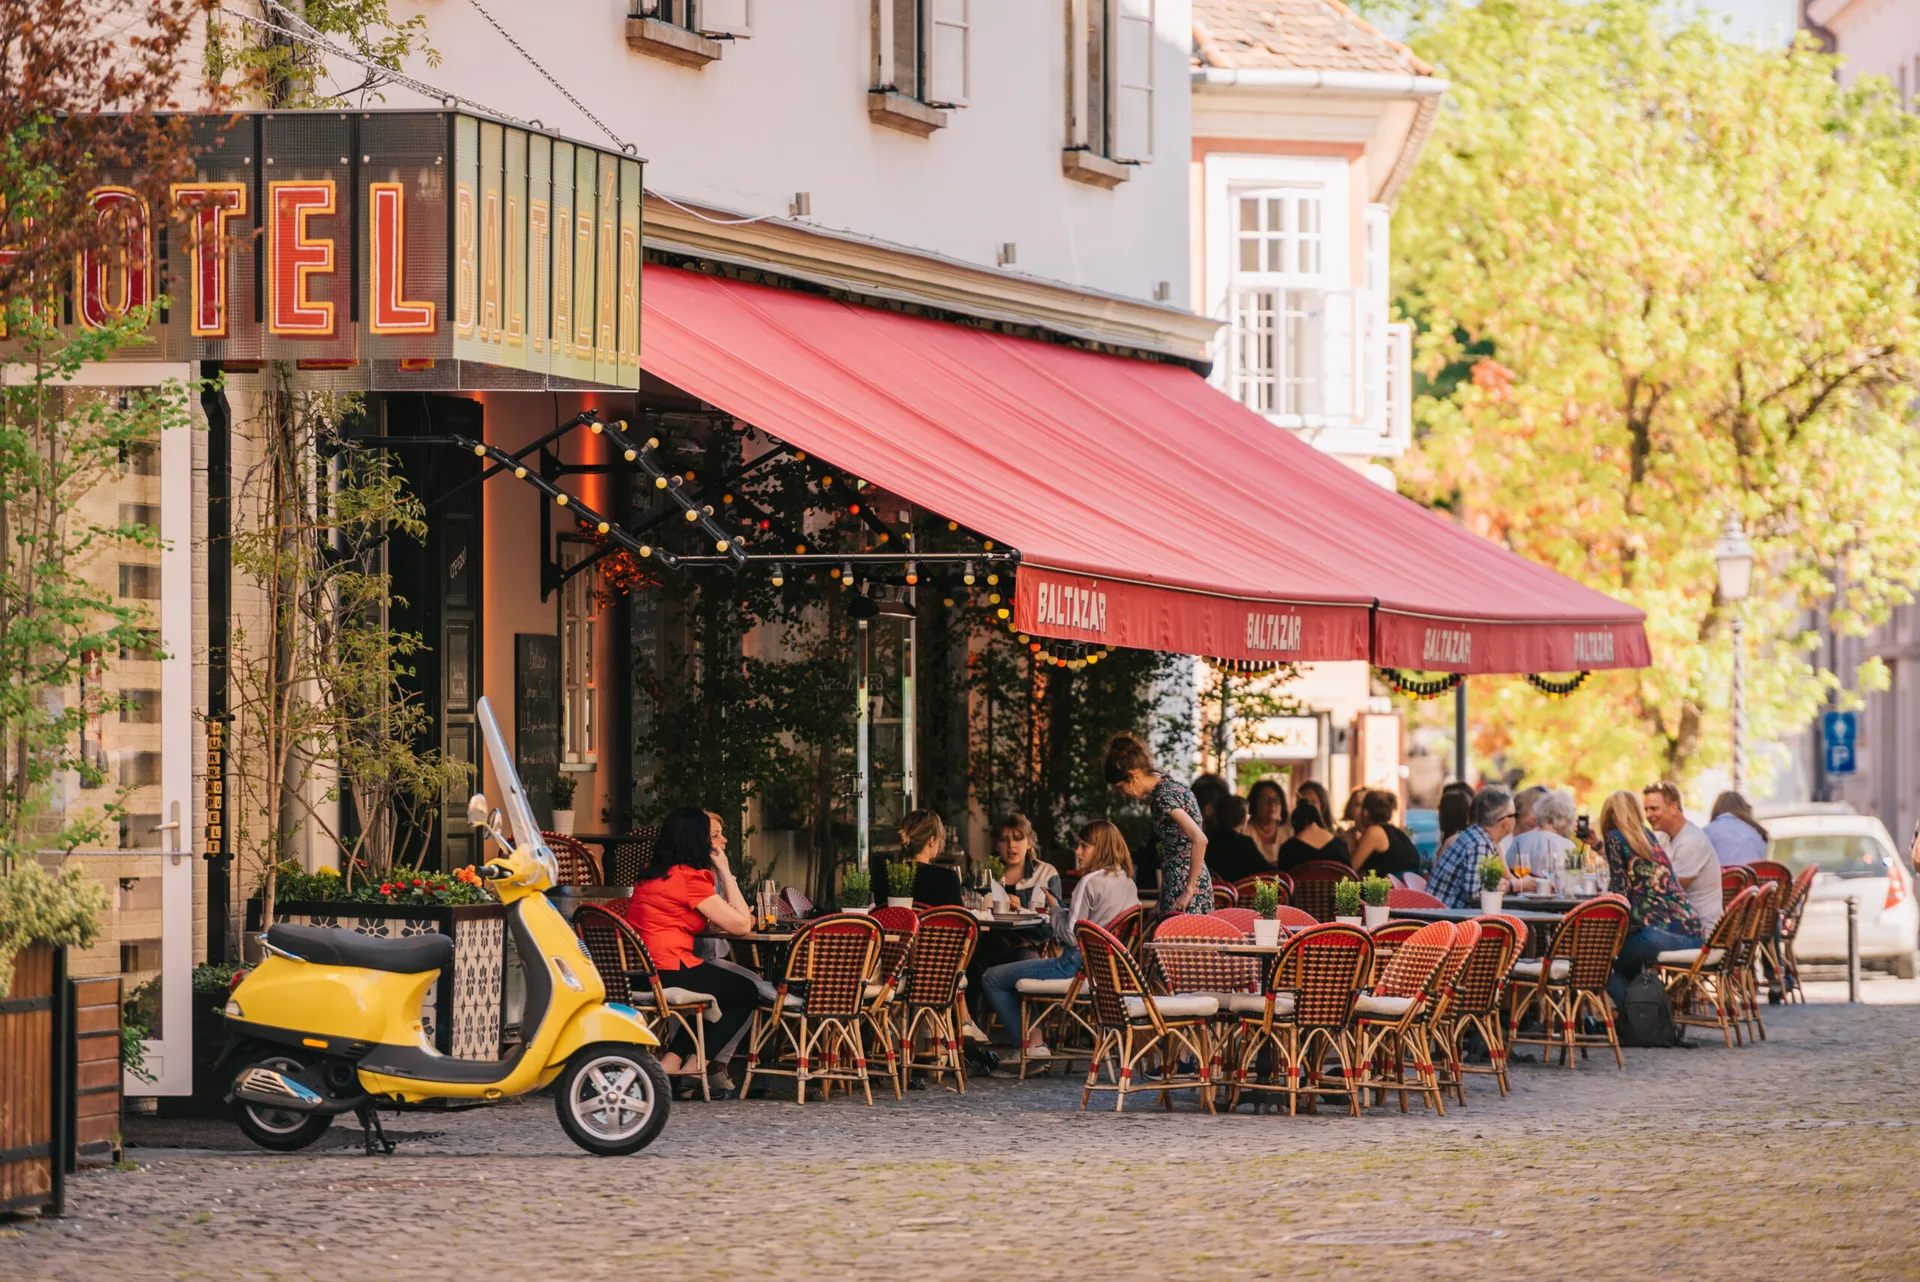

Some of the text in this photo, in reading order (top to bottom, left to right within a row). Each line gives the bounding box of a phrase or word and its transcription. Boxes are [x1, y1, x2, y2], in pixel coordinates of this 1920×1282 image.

[456, 172, 637, 366] BALTAZÁR
[1037, 580, 1107, 633] BALTAZÁR
[1247, 606, 1301, 651] BALTAZÁR
[1832, 745, 1851, 769] P
